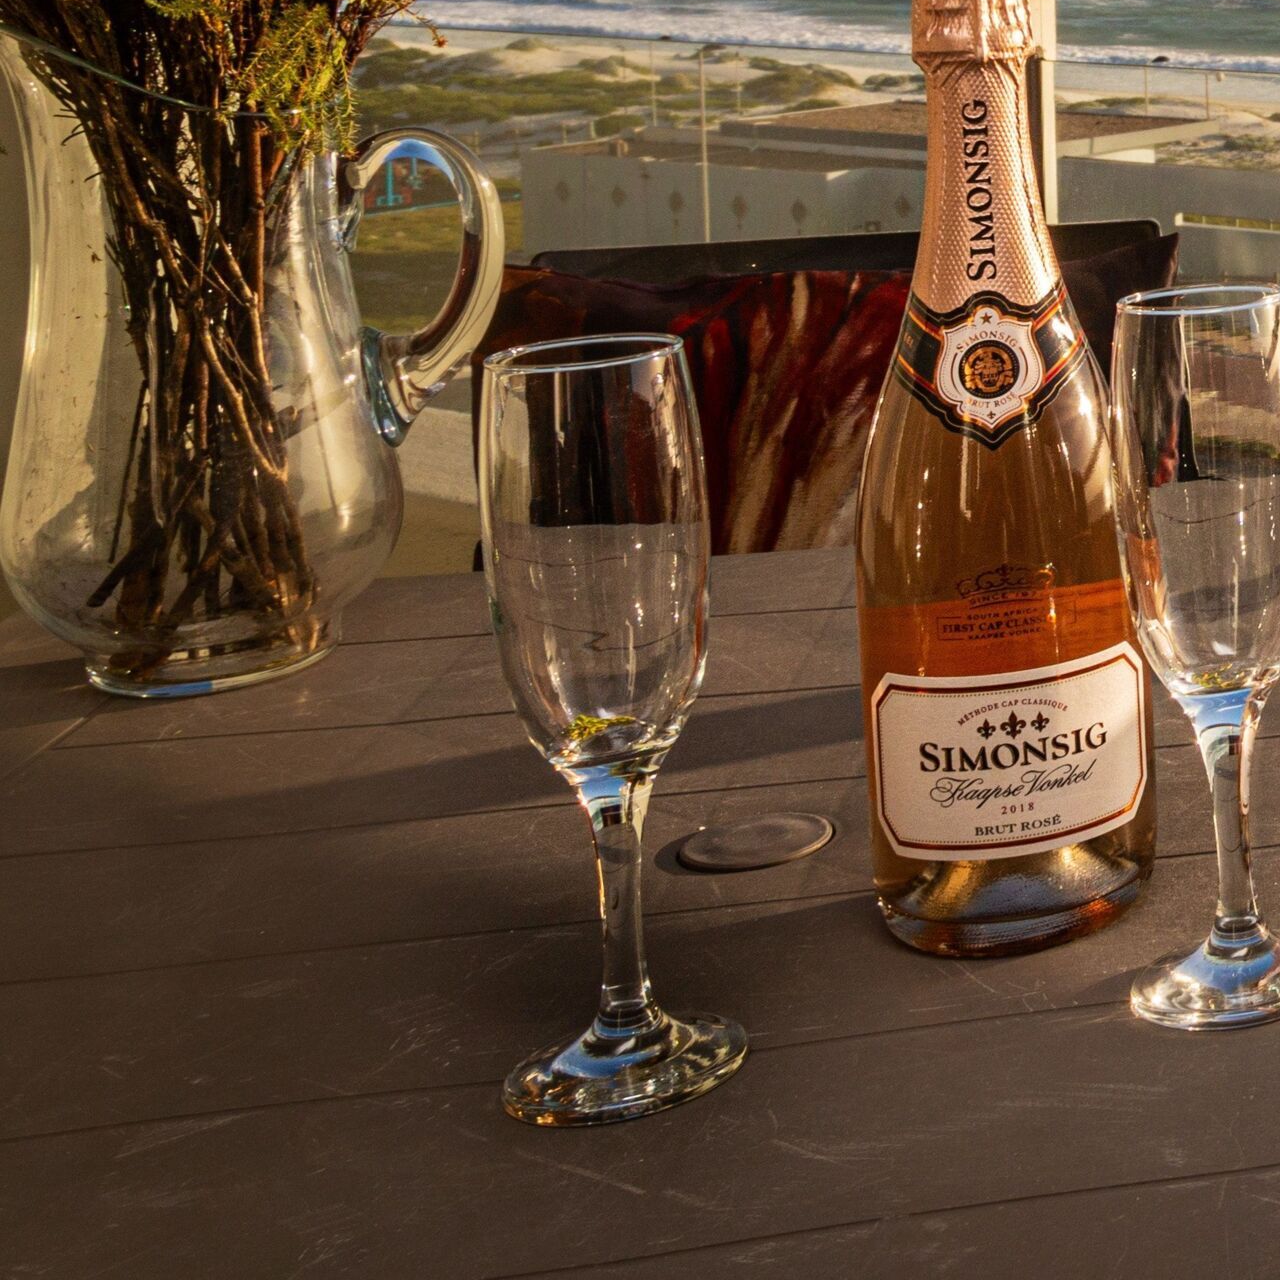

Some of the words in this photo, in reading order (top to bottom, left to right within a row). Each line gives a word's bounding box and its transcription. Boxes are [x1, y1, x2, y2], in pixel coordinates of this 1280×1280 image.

[961, 99, 997, 281] SIMONSIG
[957, 330, 1018, 353] SIMONSIG
[969, 591, 1009, 606] SINCE
[943, 623, 976, 633] FIRST
[978, 620, 1004, 631] CAP
[967, 612, 1000, 621] SOUTH
[968, 631, 1005, 641] KAAPSE
[1009, 626, 1045, 637] VONKE
[957, 702, 1000, 726] MÉTHODE
[1001, 699, 1019, 708] CAP
[1021, 698, 1069, 712] CLASSIQUE
[919, 722, 1108, 773] SIMONSIG
[929, 776, 1024, 809] Kaapse
[1020, 758, 1098, 796] Vonkel
[1001, 801, 1035, 815] 2018
[974, 822, 1017, 837] BRUT
[1020, 813, 1062, 832] ROSÉ
